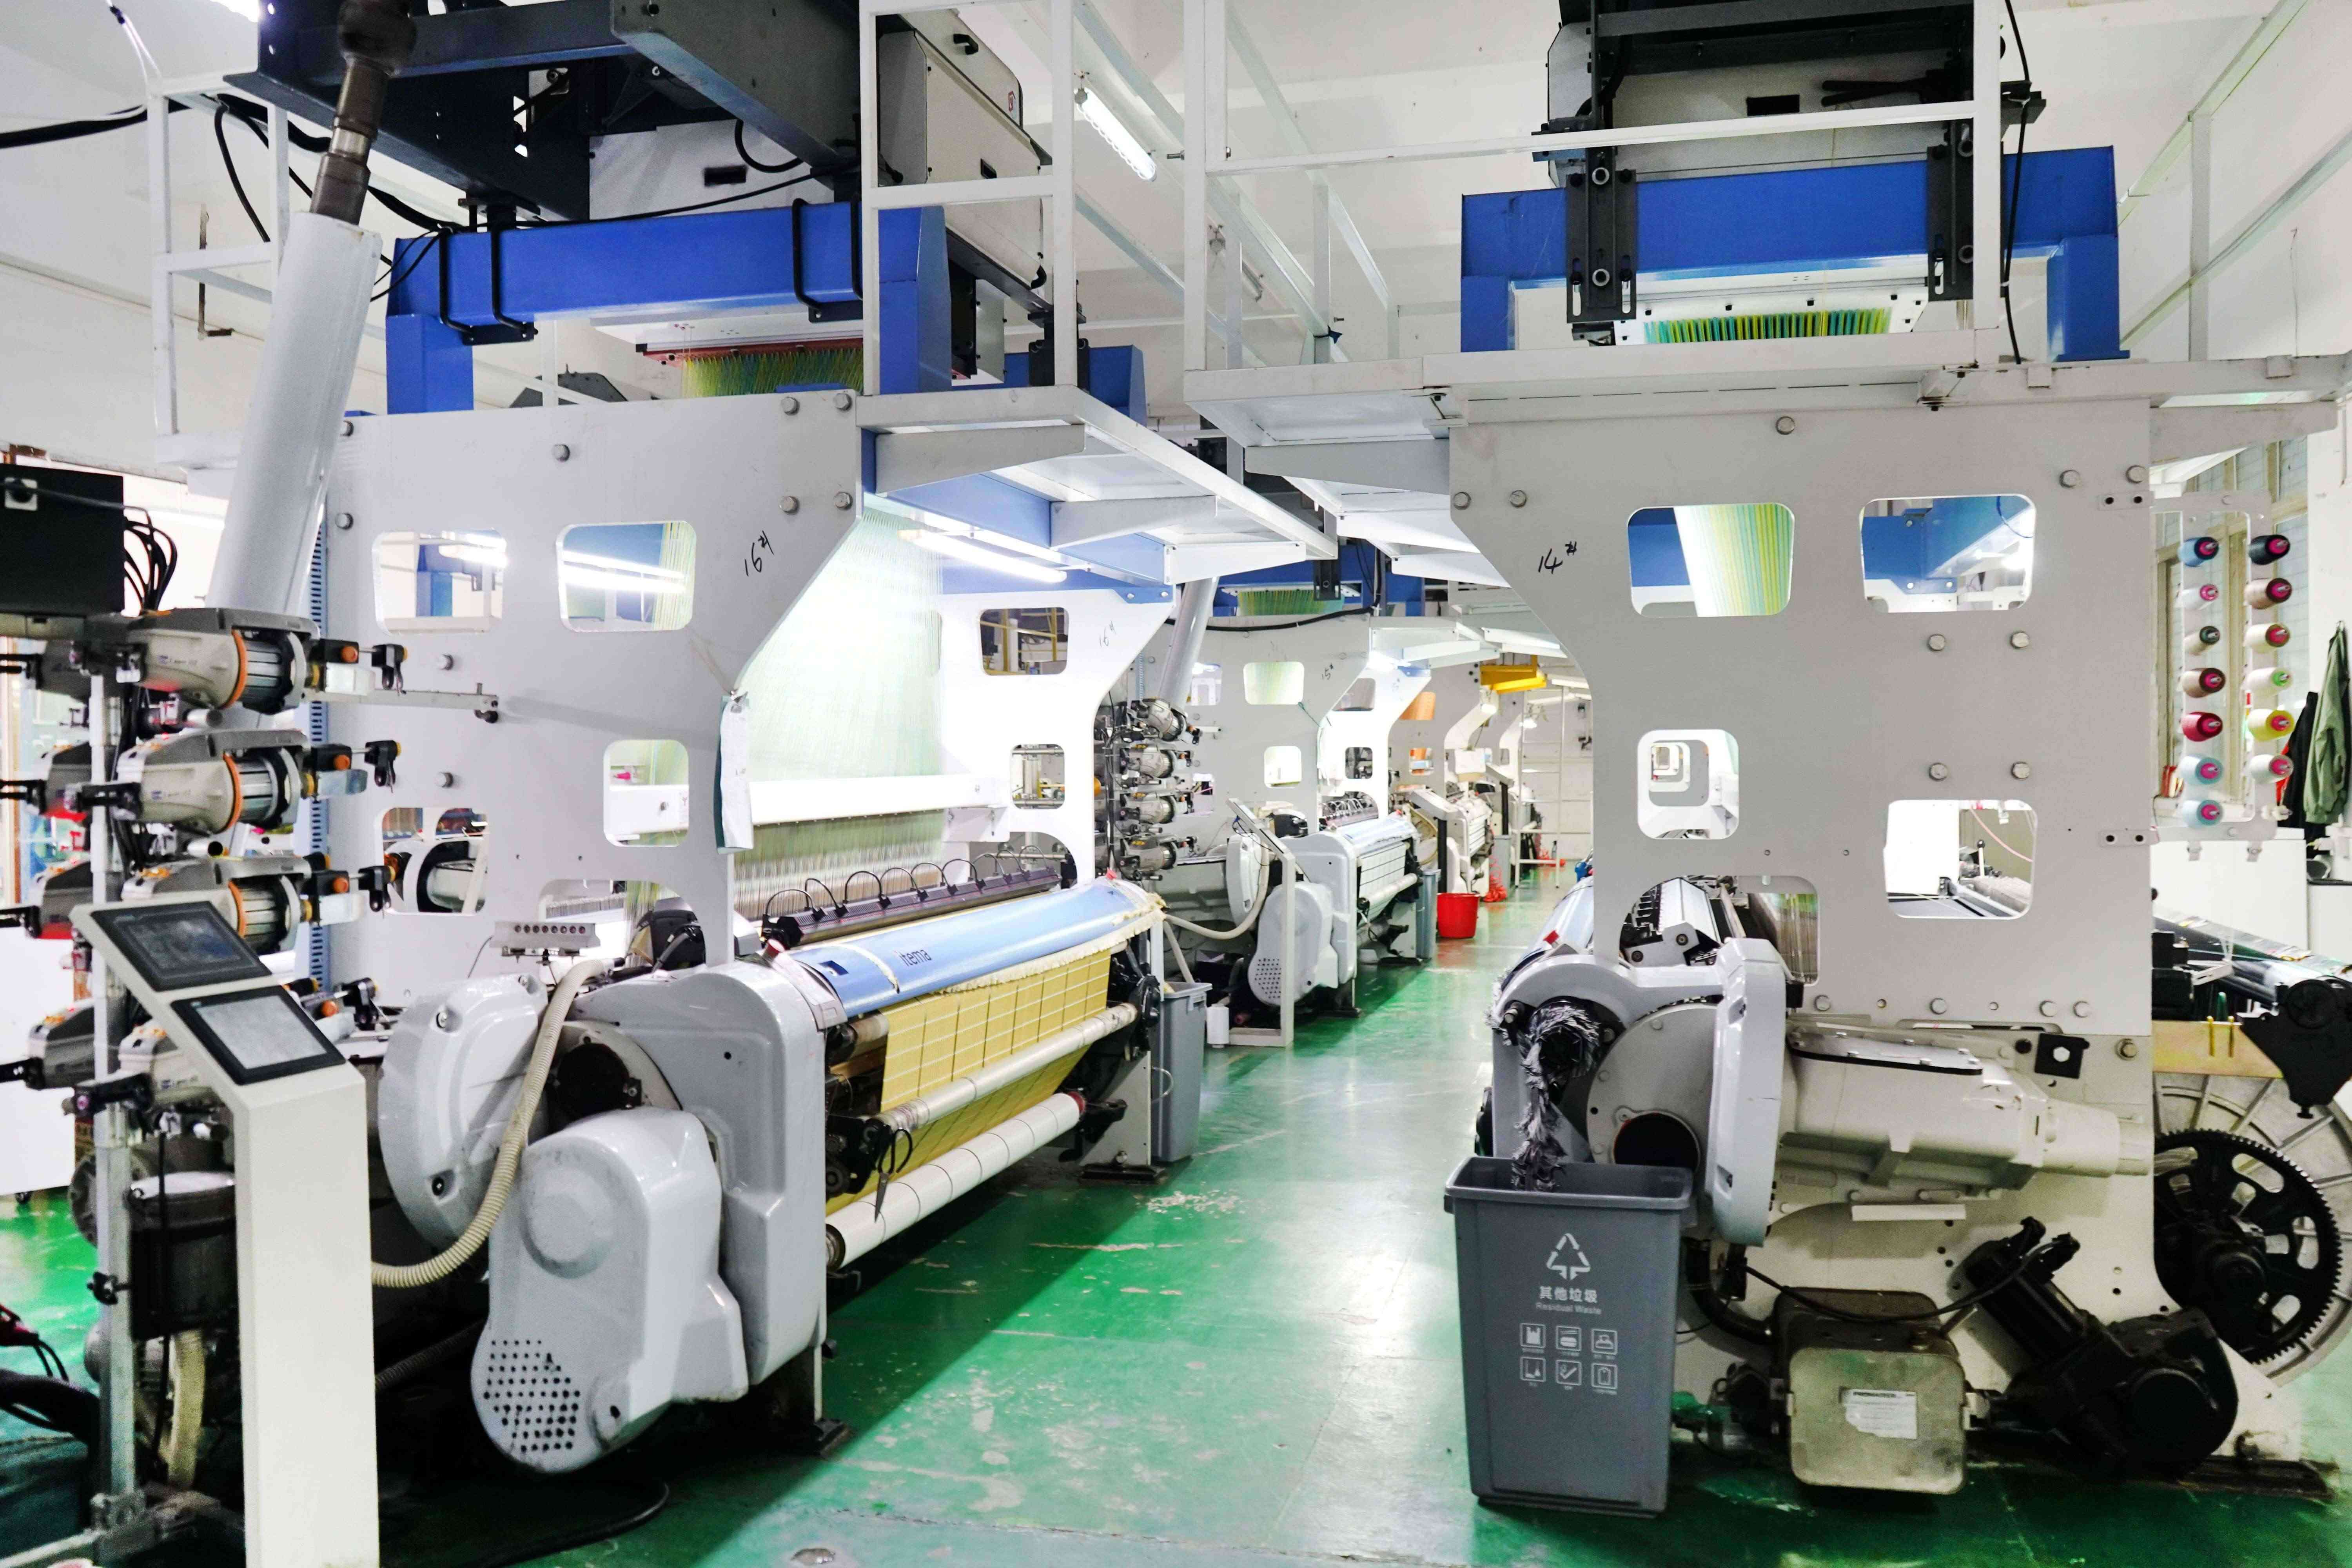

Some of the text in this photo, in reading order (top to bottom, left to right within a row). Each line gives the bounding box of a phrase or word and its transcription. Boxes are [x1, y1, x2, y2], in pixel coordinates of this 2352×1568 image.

[1538, 541, 1577, 575] 14#
[897, 948, 932, 967] itema
[1539, 1286, 1597, 1303] 其他垃圾
[1535, 1302, 1602, 1314] Residual Waste
